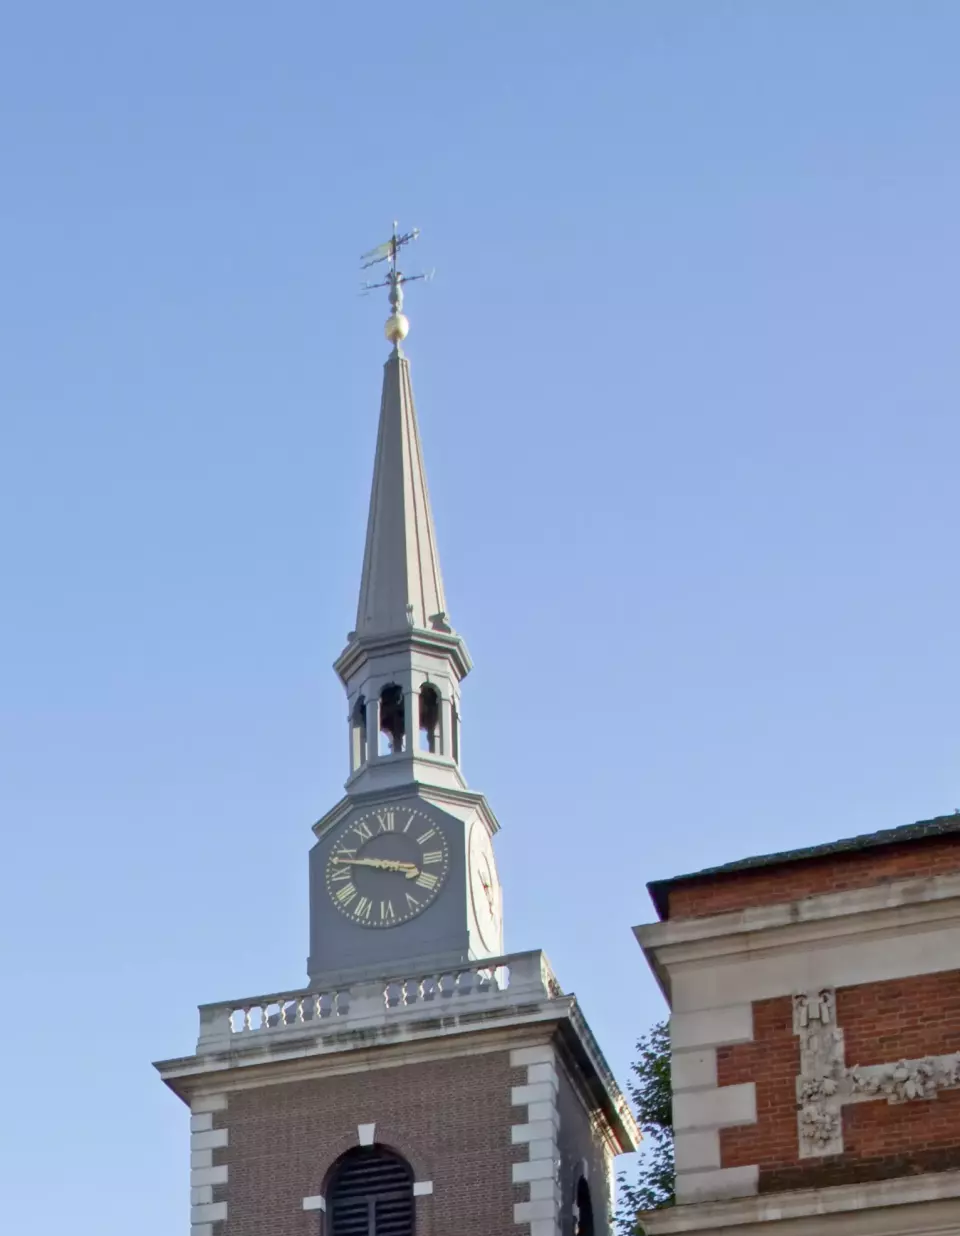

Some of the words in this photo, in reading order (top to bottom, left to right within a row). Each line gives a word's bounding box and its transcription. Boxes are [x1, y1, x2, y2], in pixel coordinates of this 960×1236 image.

[377, 812, 394, 834] XII
[403, 815, 415, 833] I
[353, 822, 373, 844] XI
[416, 829, 436, 845] II
[337, 843, 357, 859] X
[423, 851, 442, 865] III
[331, 866, 351, 881] IX
[416, 871, 439, 890] IIII
[335, 882, 358, 907] VIII
[405, 892, 419, 910] V
[354, 896, 373, 919] VII
[380, 900, 395, 919] VI
